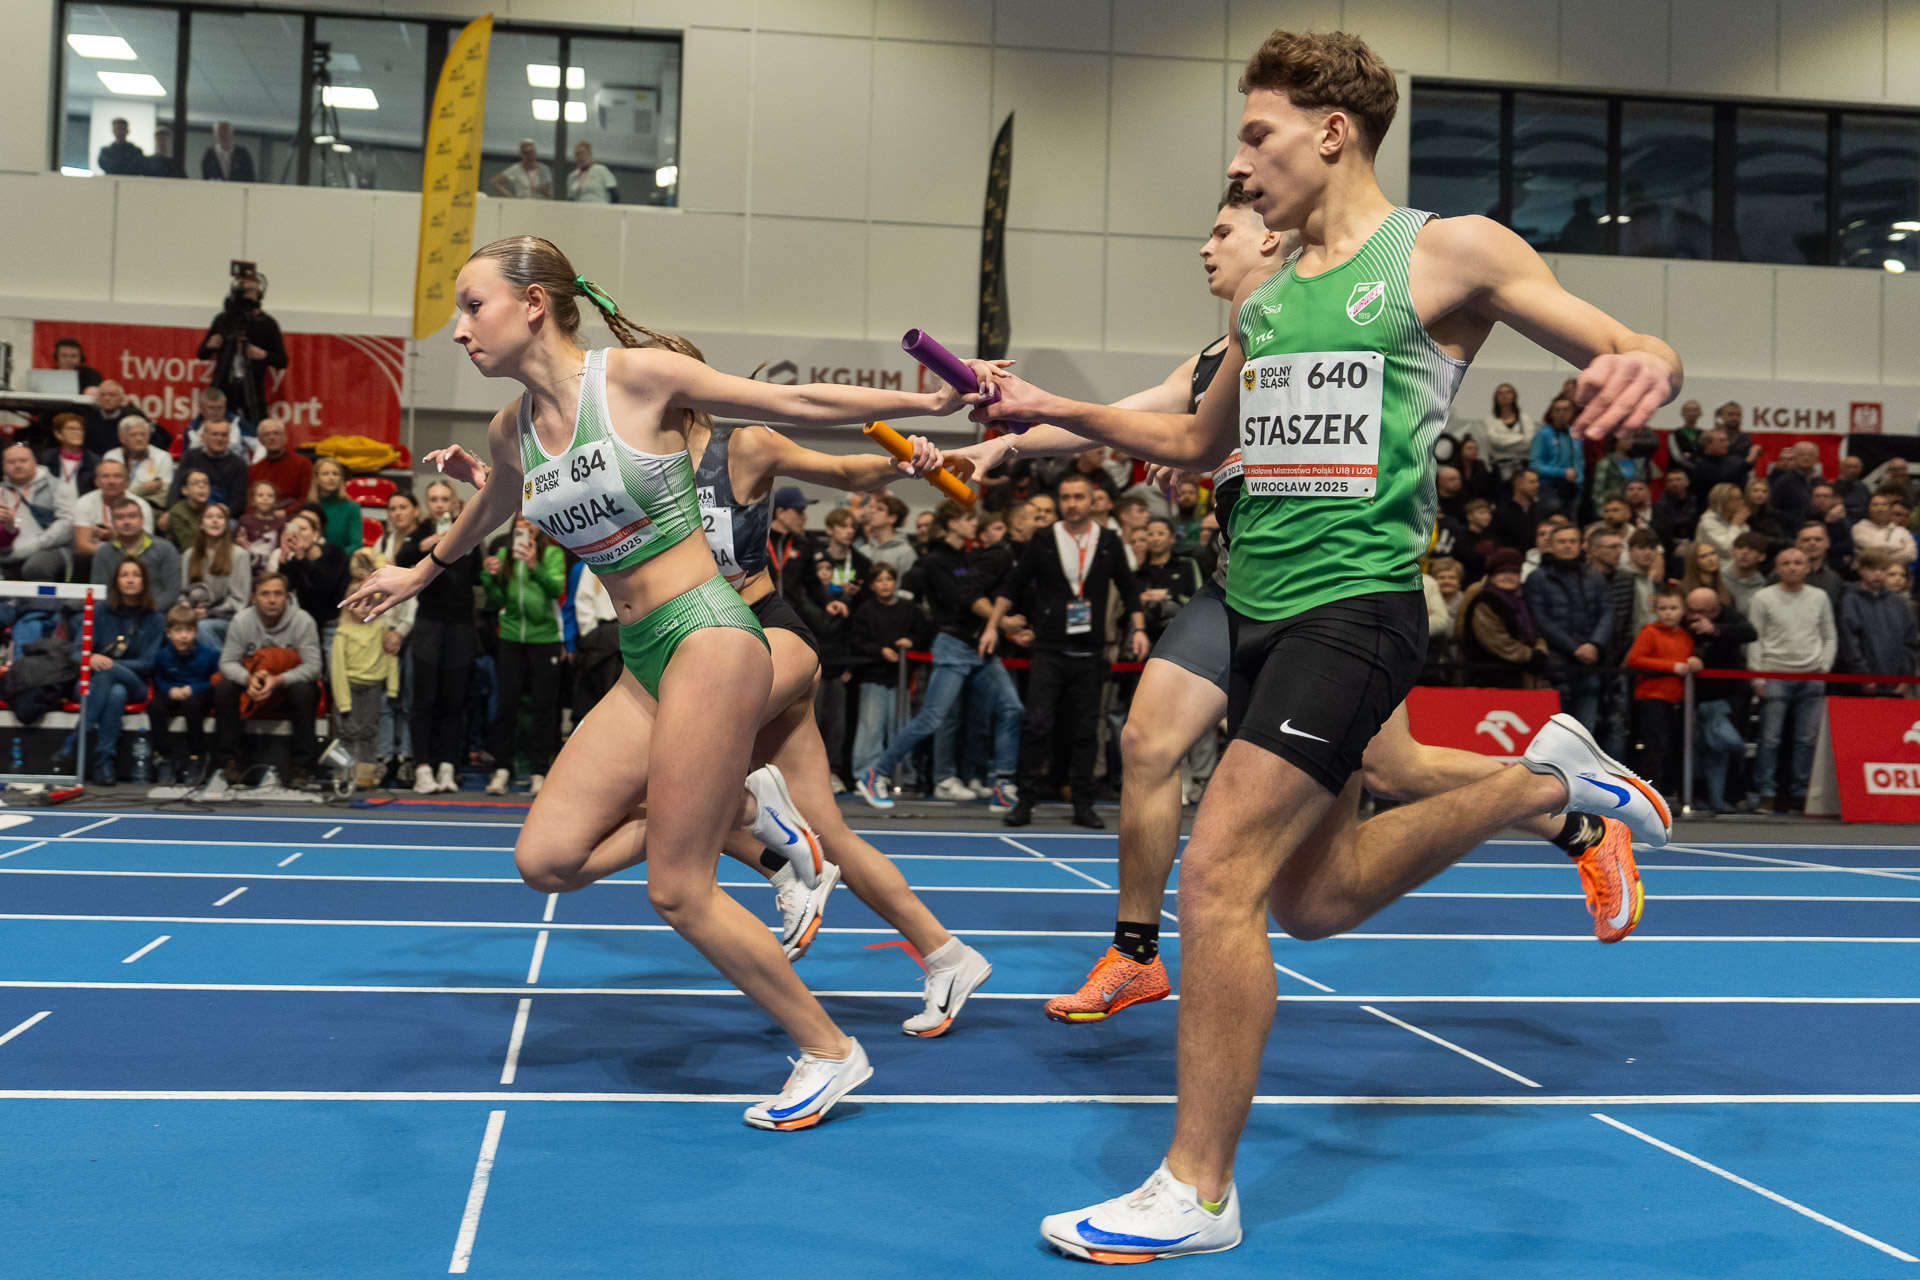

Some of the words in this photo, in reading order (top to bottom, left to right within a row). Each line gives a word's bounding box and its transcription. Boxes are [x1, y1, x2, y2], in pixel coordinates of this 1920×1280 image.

[120, 349, 285, 393] tworzy
[810, 366, 903, 391] KGHM
[1260, 365, 1292, 378] DOLNY
[1260, 375, 1290, 390] ŚLĄSK
[1307, 361, 1368, 389] 640
[270, 396, 323, 426] ort
[1752, 406, 1836, 429] KGHM
[1244, 414, 1369, 446] STASZEK
[535, 468, 560, 486] DOLNY
[570, 449, 606, 483] 634
[1273, 467, 1311, 475] Mistrzostwa
[1312, 466, 1335, 475] Polski
[1336, 467, 1350, 475] U18
[1356, 467, 1373, 475] U20
[535, 478, 560, 495] ŚLĄSK
[1251, 481, 1312, 492] WROCŁAW
[1314, 481, 1349, 492] 2025
[537, 493, 625, 537] MUSIAŁ
[614, 535, 642, 556] 2025
